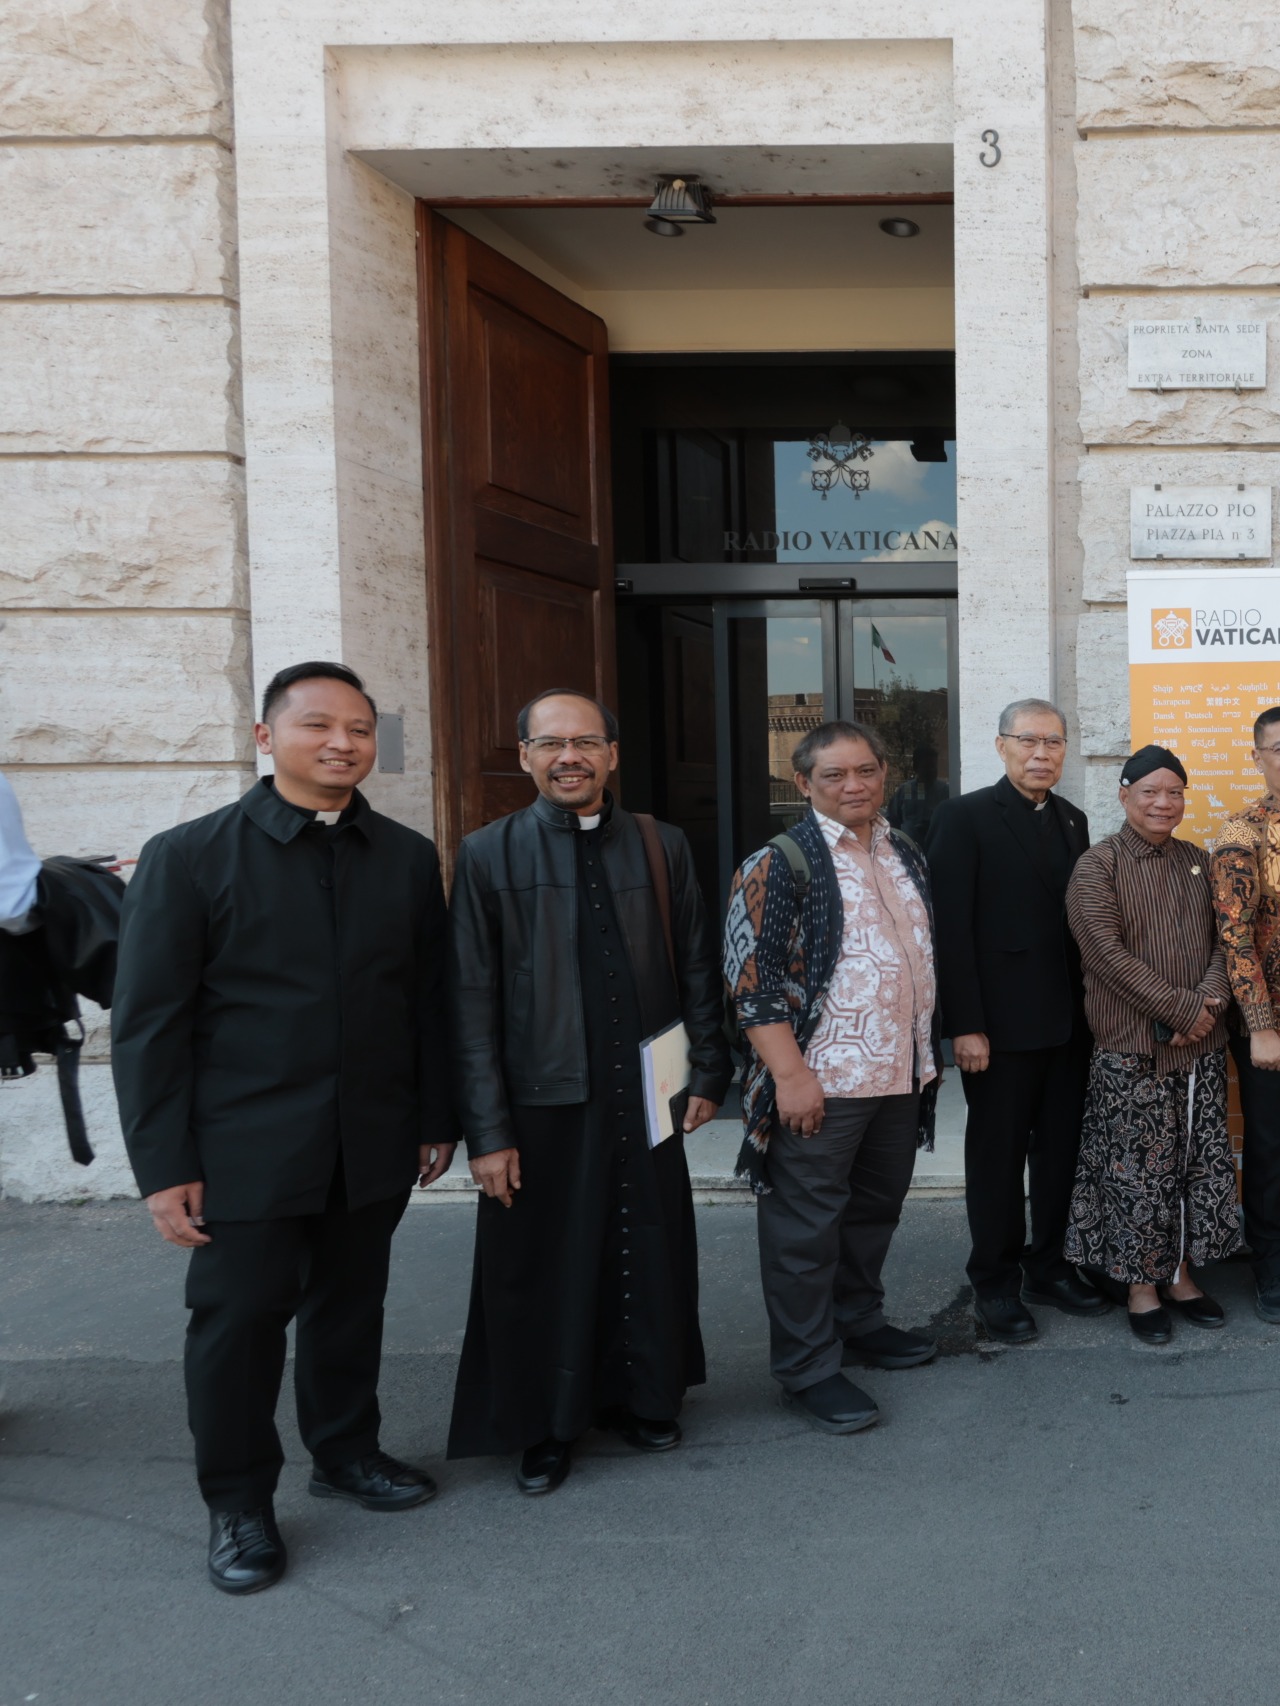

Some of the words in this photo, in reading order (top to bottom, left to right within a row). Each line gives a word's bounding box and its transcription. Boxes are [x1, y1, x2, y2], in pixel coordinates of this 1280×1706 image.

[979, 129, 1001, 168] 3
[1195, 325, 1230, 334] SANTA
[1236, 325, 1260, 334] SEDE
[1182, 350, 1212, 358] ZONA
[1138, 373, 1173, 383] EXTRA
[1179, 373, 1255, 383] TERRITORIALE
[1146, 504, 1218, 517] PALAZZO
[1227, 504, 1255, 517] PIO
[1147, 528, 1198, 540] PIAZZA
[1202, 529, 1224, 540] PIA
[1246, 528, 1255, 540] 3
[724, 531, 812, 551] RADIO
[820, 531, 957, 551] VATICANA
[1196, 609, 1261, 626] RADIO
[1153, 685, 1173, 693] Shqip
[1153, 698, 1190, 707] Български
[1203, 753, 1228, 762] 한국어
[1189, 768, 1234, 776] Македонски
